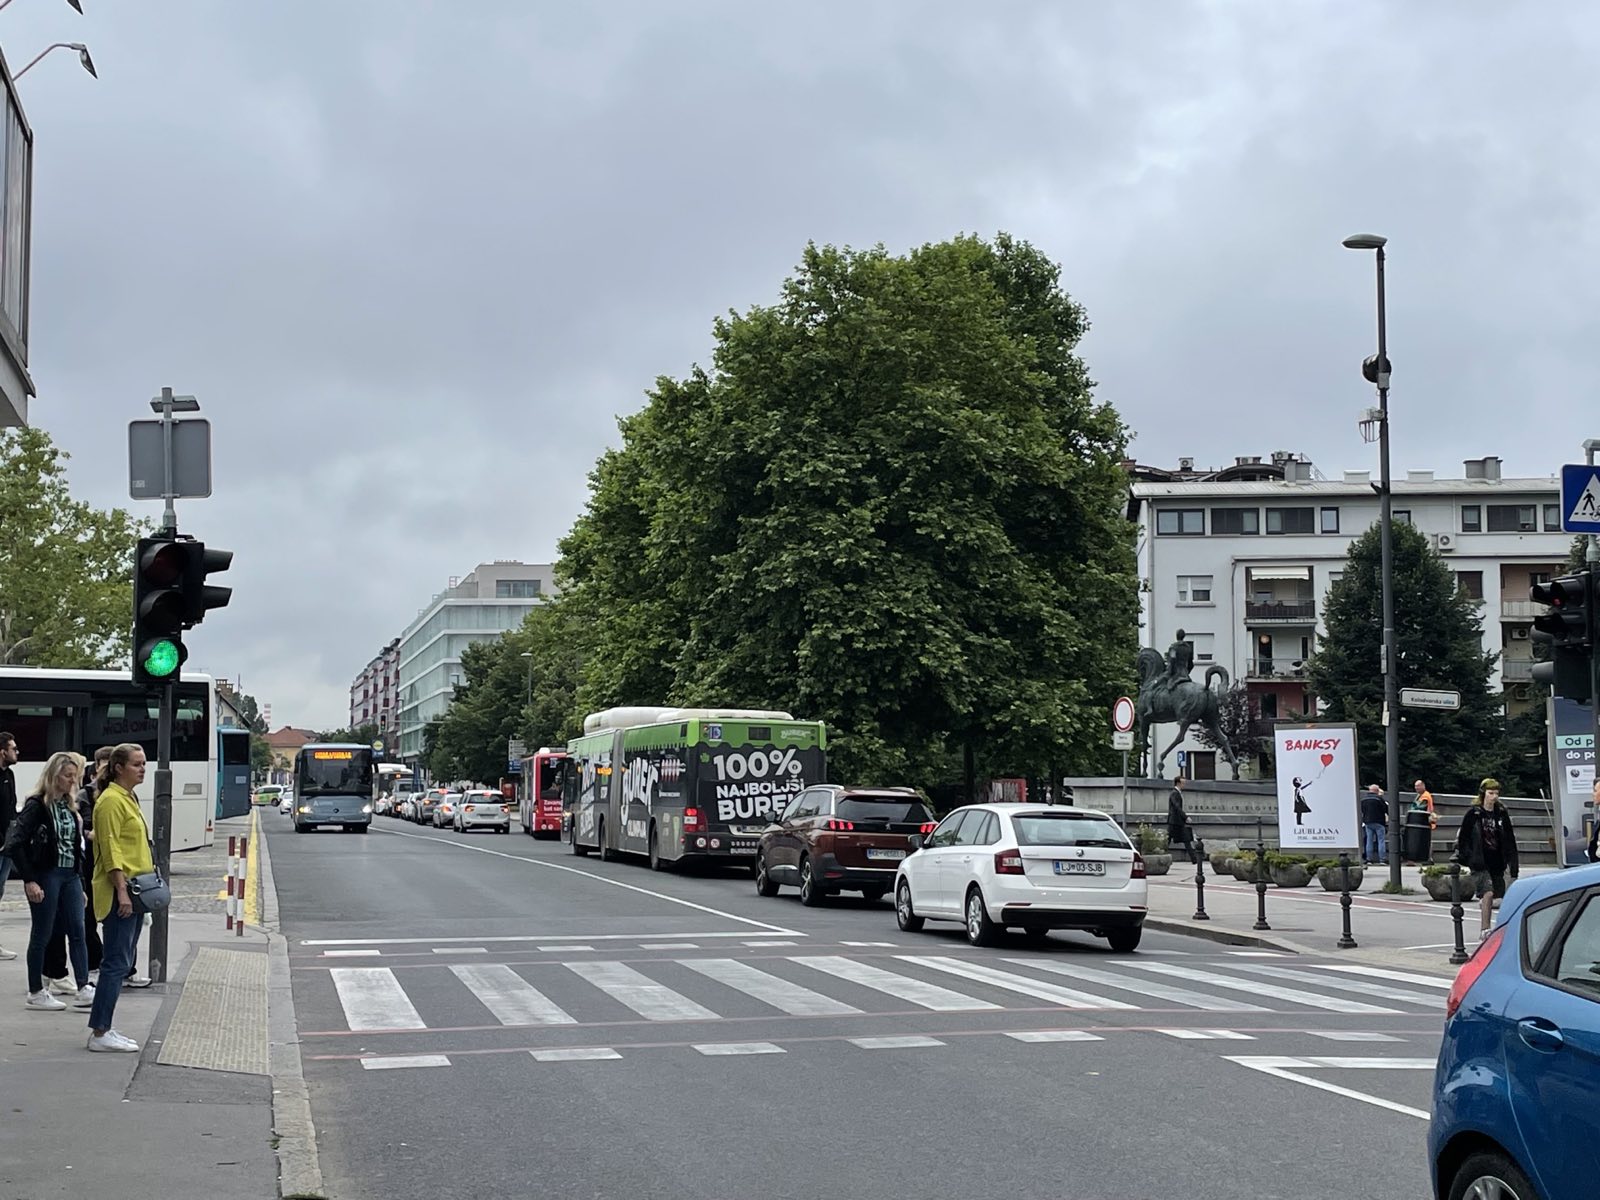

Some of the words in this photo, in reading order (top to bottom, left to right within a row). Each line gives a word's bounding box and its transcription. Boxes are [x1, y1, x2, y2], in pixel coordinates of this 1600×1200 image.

[1285, 739, 1341, 751] BANKSY
[1565, 737, 1581, 746] Od
[1566, 750, 1581, 760] do
[713, 749, 802, 780] 100%
[1061, 863, 1071, 871] LJ
